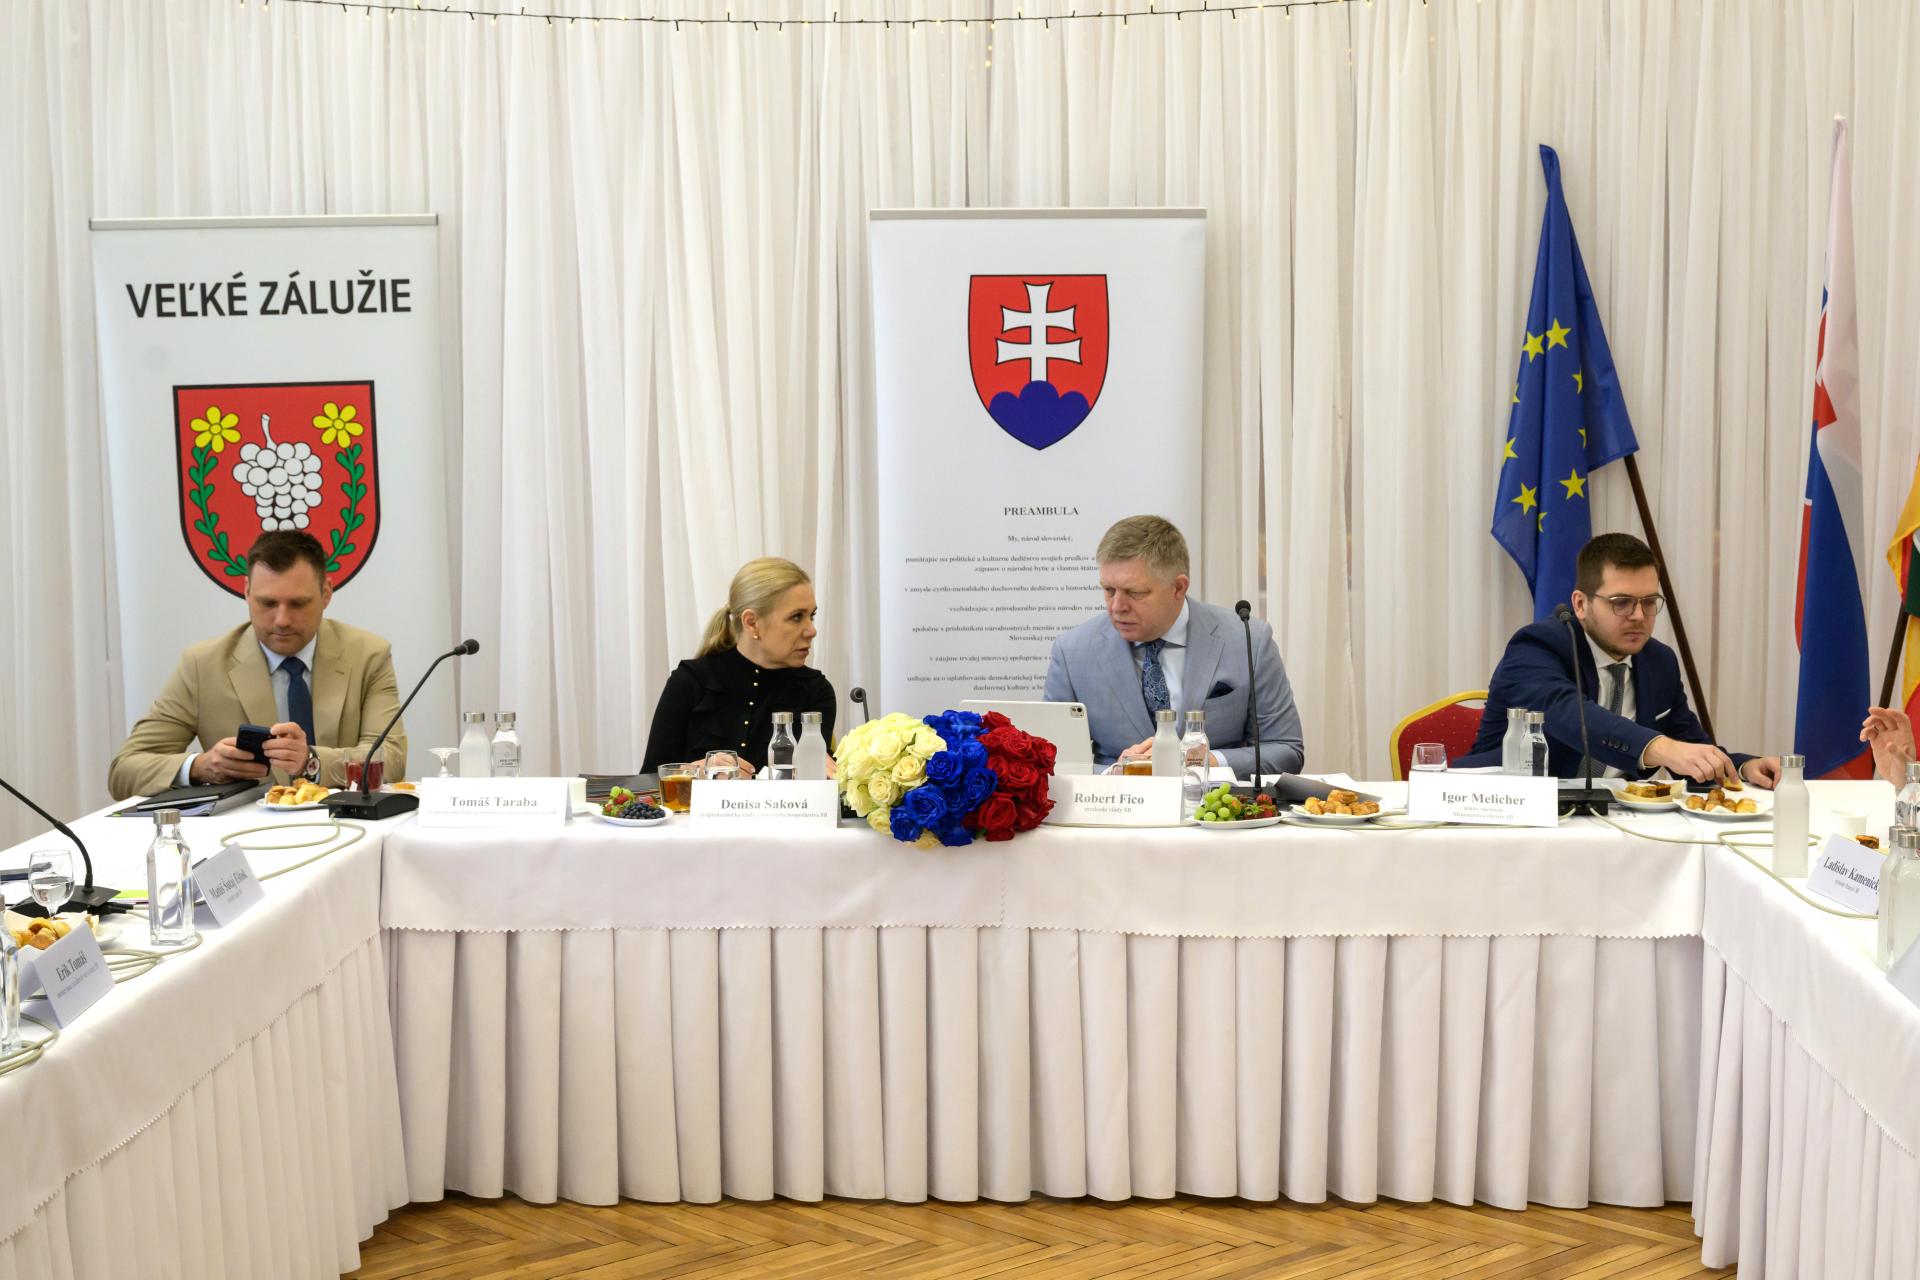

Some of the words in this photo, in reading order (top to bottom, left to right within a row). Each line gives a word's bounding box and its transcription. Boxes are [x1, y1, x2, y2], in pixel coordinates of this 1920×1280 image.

[126, 271, 248, 318] VEĽKÉ
[259, 269, 411, 315] ZÁLUŽIE
[1004, 506, 1079, 516] PREAMBULA
[449, 796, 490, 807] Tomáš
[493, 796, 537, 807] Taraba
[721, 799, 761, 810] Denisa
[764, 798, 809, 810] Saková
[1074, 792, 1116, 804] Robert
[1119, 793, 1145, 805] Fico
[1442, 791, 1468, 804] Igor
[1471, 793, 1526, 806] Melicher
[1824, 856, 1850, 876] Ladislav
[56, 964, 71, 982] Erik
[67, 950, 88, 973] Tomáš
